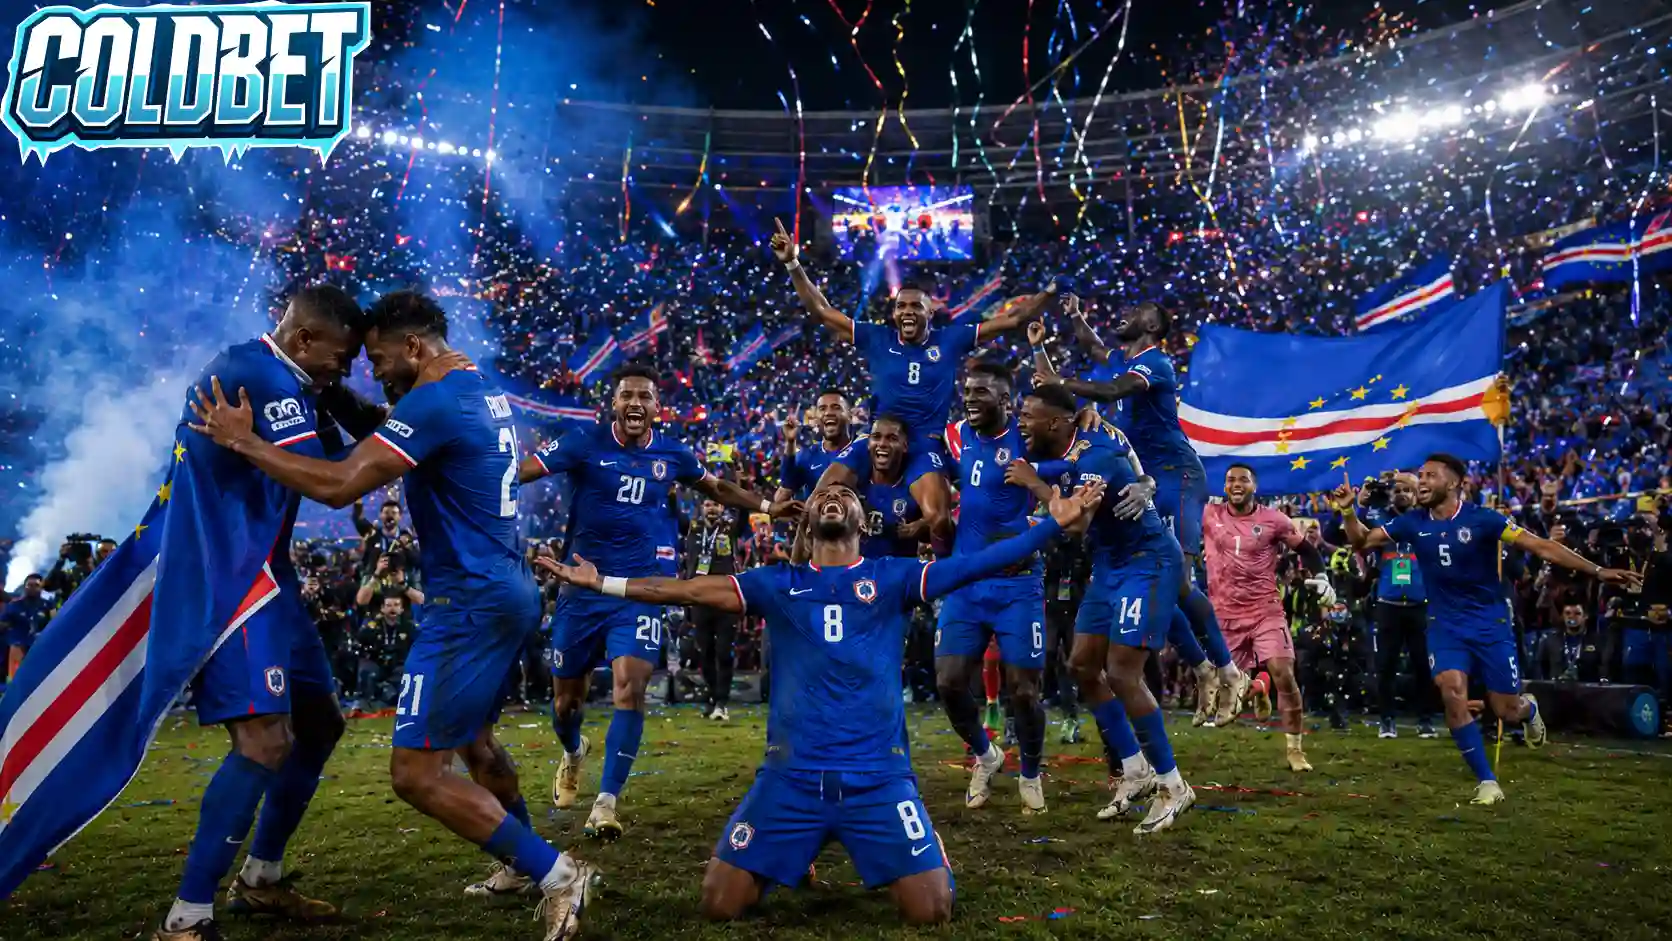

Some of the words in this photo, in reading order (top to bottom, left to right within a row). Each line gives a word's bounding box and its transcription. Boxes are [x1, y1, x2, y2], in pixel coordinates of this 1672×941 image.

[908, 362, 921, 384] 8
[970, 459, 984, 487] 6
[616, 475, 646, 505] 20
[1231, 535, 1241, 556] 1
[1438, 544, 1452, 567] 5
[823, 604, 844, 643] 8
[1118, 596, 1143, 626] 14
[635, 614, 661, 645] 20
[1031, 621, 1043, 649] 6
[1508, 656, 1519, 680] 5
[395, 673, 425, 716] 21
[896, 800, 926, 841] 8
